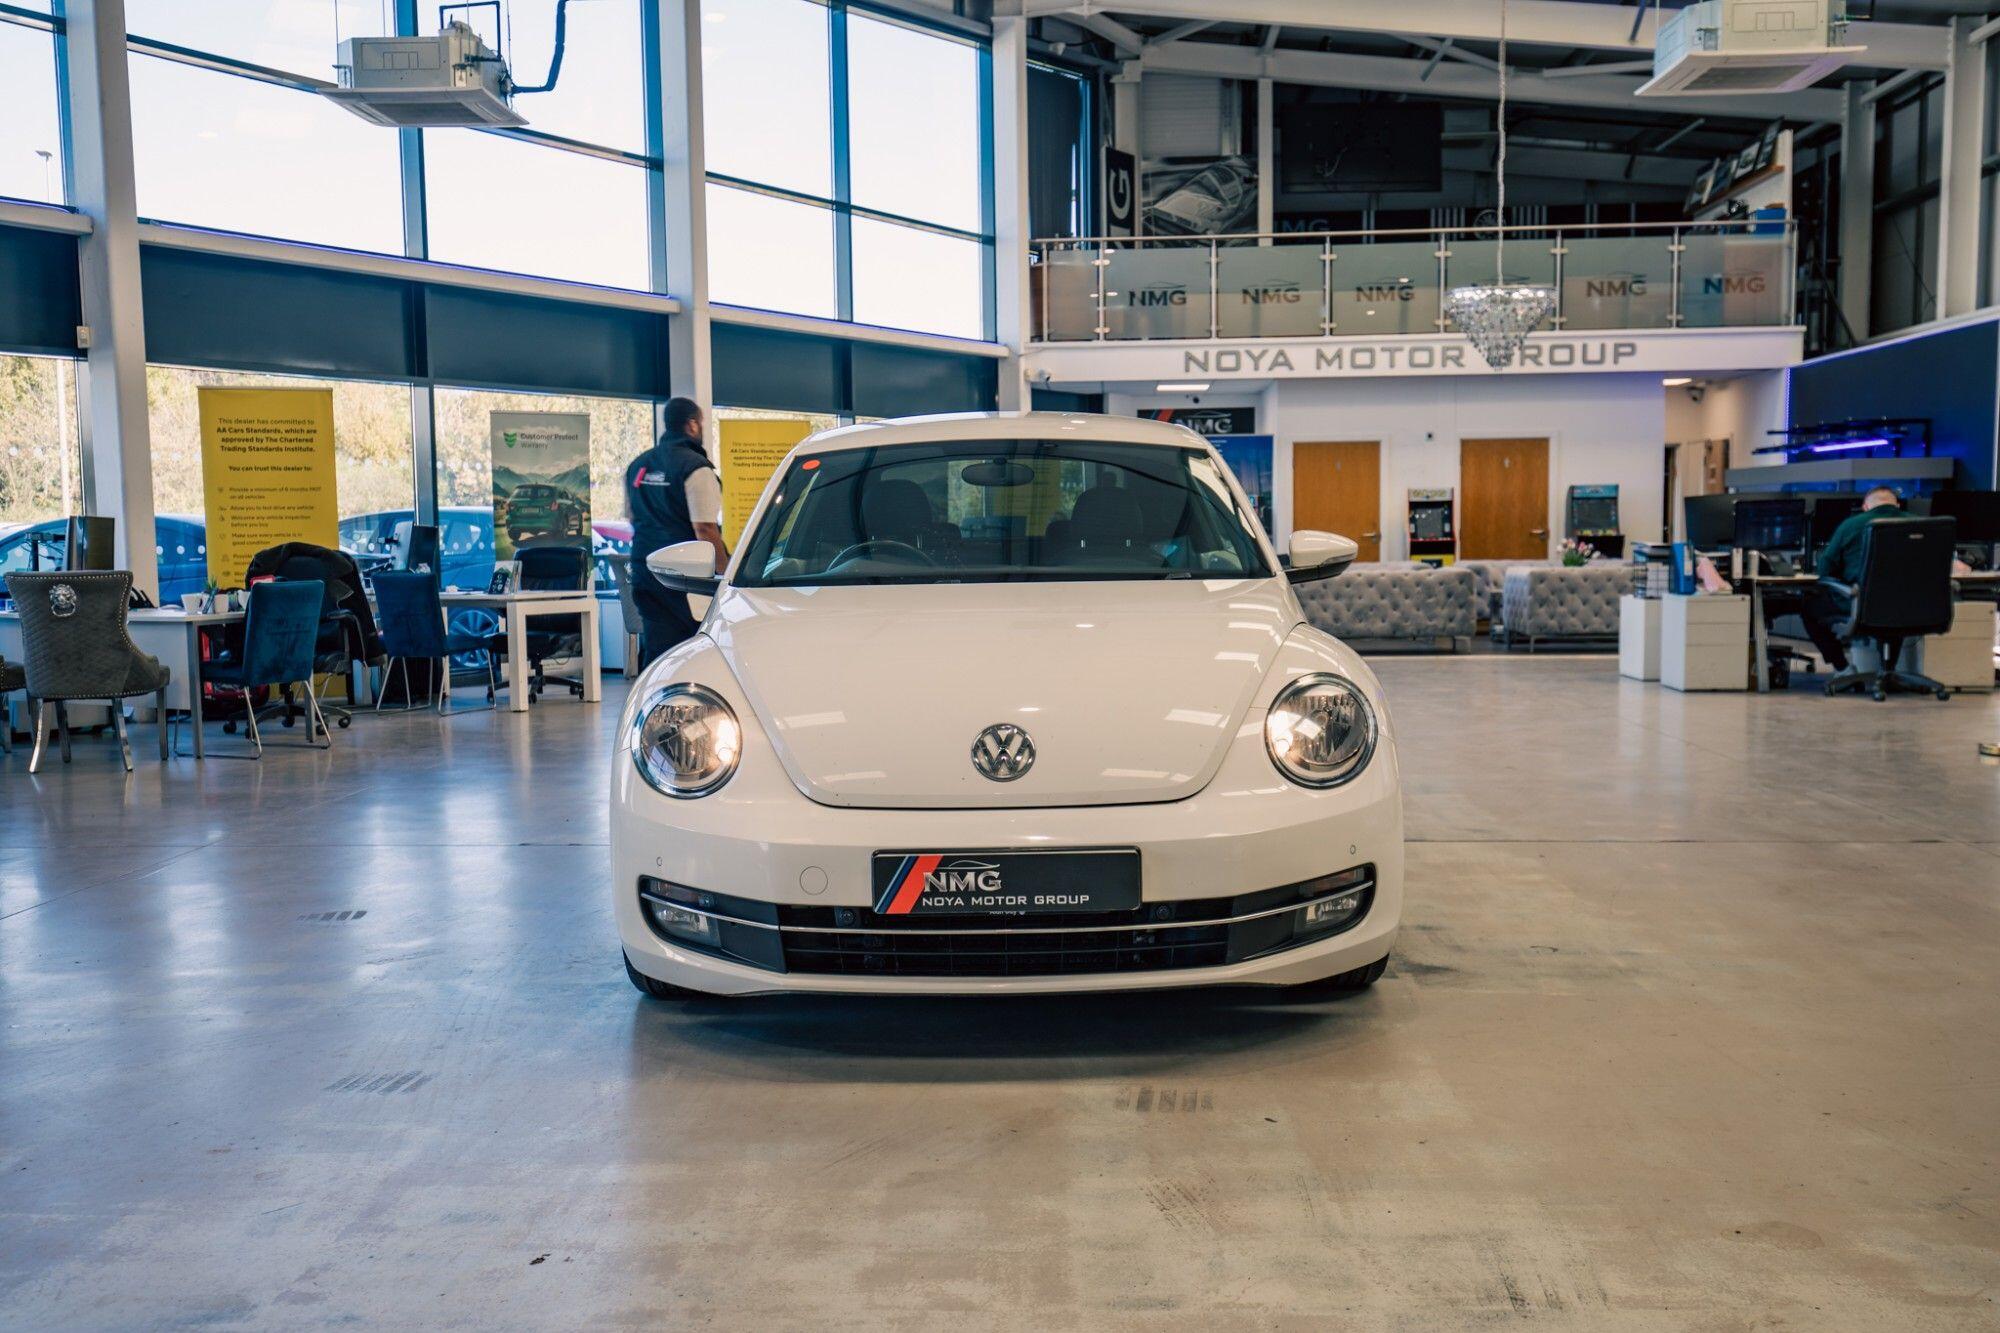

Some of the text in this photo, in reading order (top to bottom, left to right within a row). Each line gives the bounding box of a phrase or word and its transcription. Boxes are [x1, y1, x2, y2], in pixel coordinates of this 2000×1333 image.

[1355, 285, 1415, 302] NMG
[1587, 278, 1648, 297] NMG
[1703, 276, 1766, 294] NMG
[1129, 289, 1187, 306] NMG
[1242, 286, 1300, 304] NMG
[1184, 349, 1294, 372] NOYA
[1316, 346, 1465, 370] MOTOR
[976, 726, 1033, 777] VW
[923, 870, 1001, 893] NMG
[922, 894, 1090, 906] NOYA MOTOR GROUP
